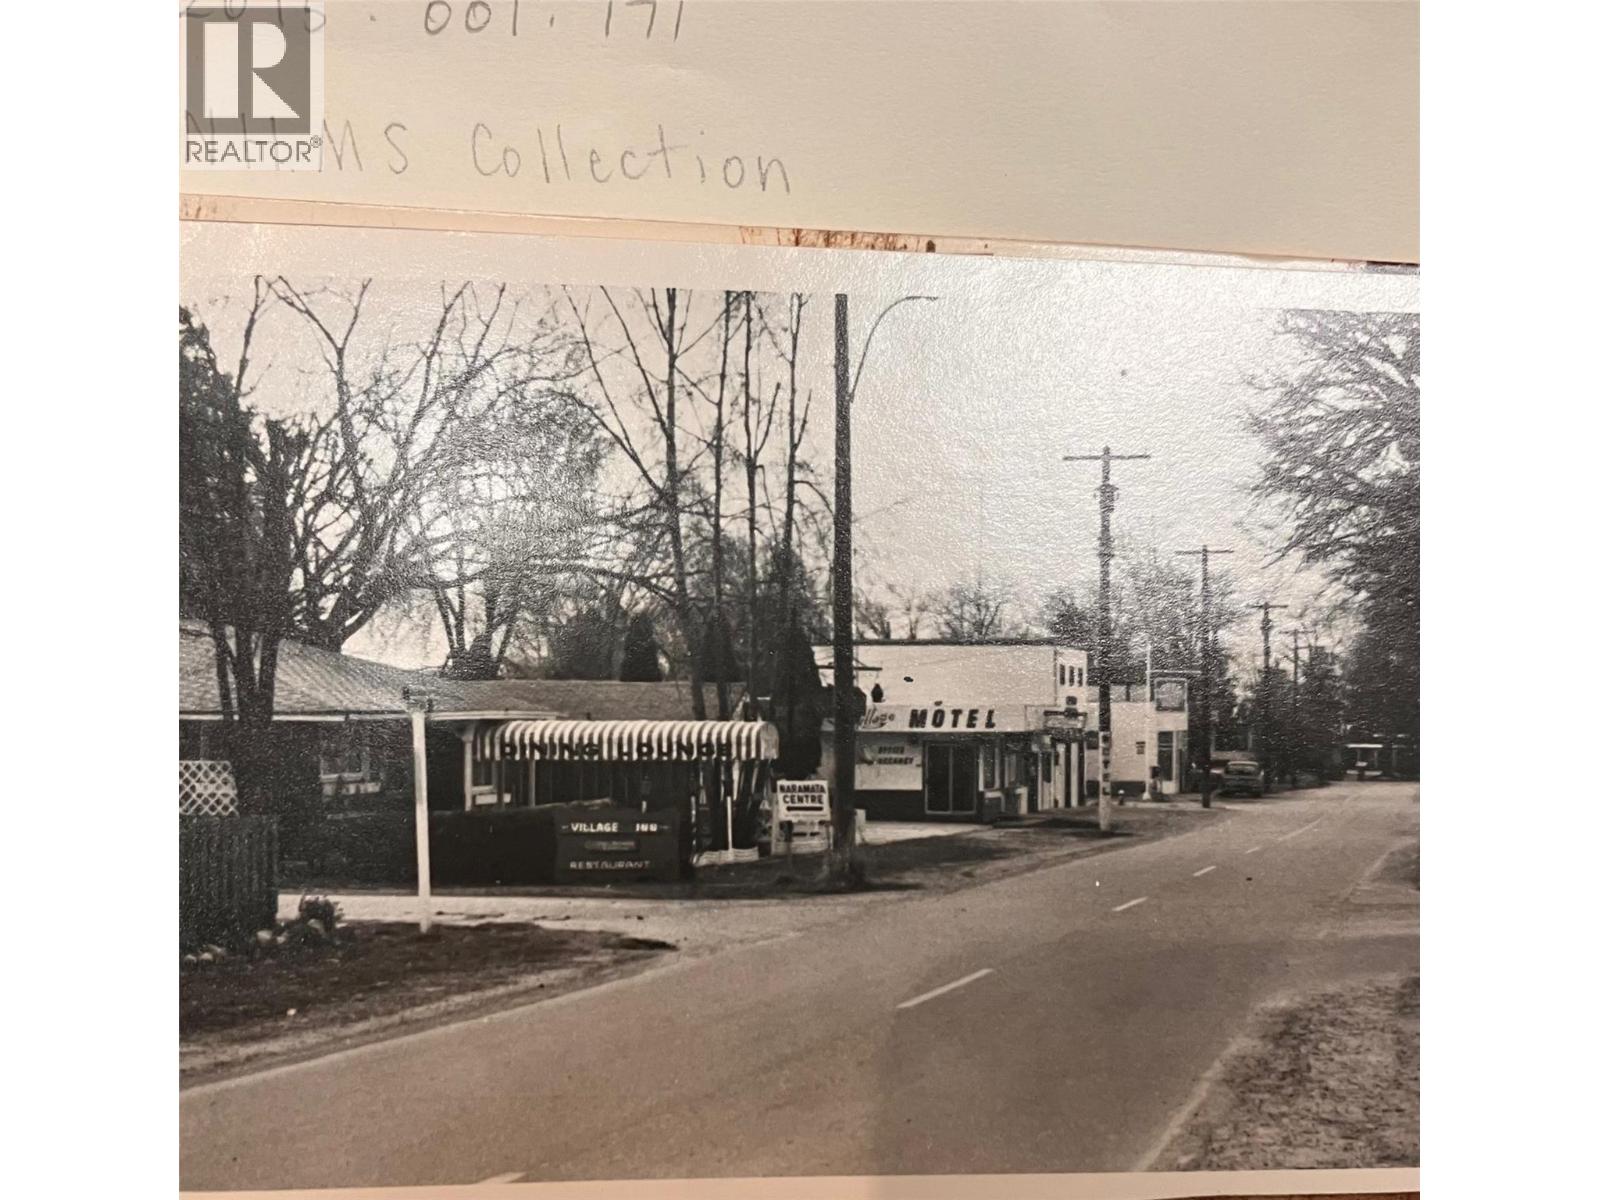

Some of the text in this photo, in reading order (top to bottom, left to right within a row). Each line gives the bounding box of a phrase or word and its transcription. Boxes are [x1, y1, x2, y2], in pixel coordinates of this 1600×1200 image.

[472, 122, 791, 195] Collection
[908, 708, 997, 729] MOTEL
[500, 741, 732, 759] DINING LOUNGE
[779, 783, 826, 794] NARAMATA
[783, 794, 824, 805] CENTRE
[570, 821, 619, 833] VILLAGE
[570, 859, 652, 871] RESTAURANT
